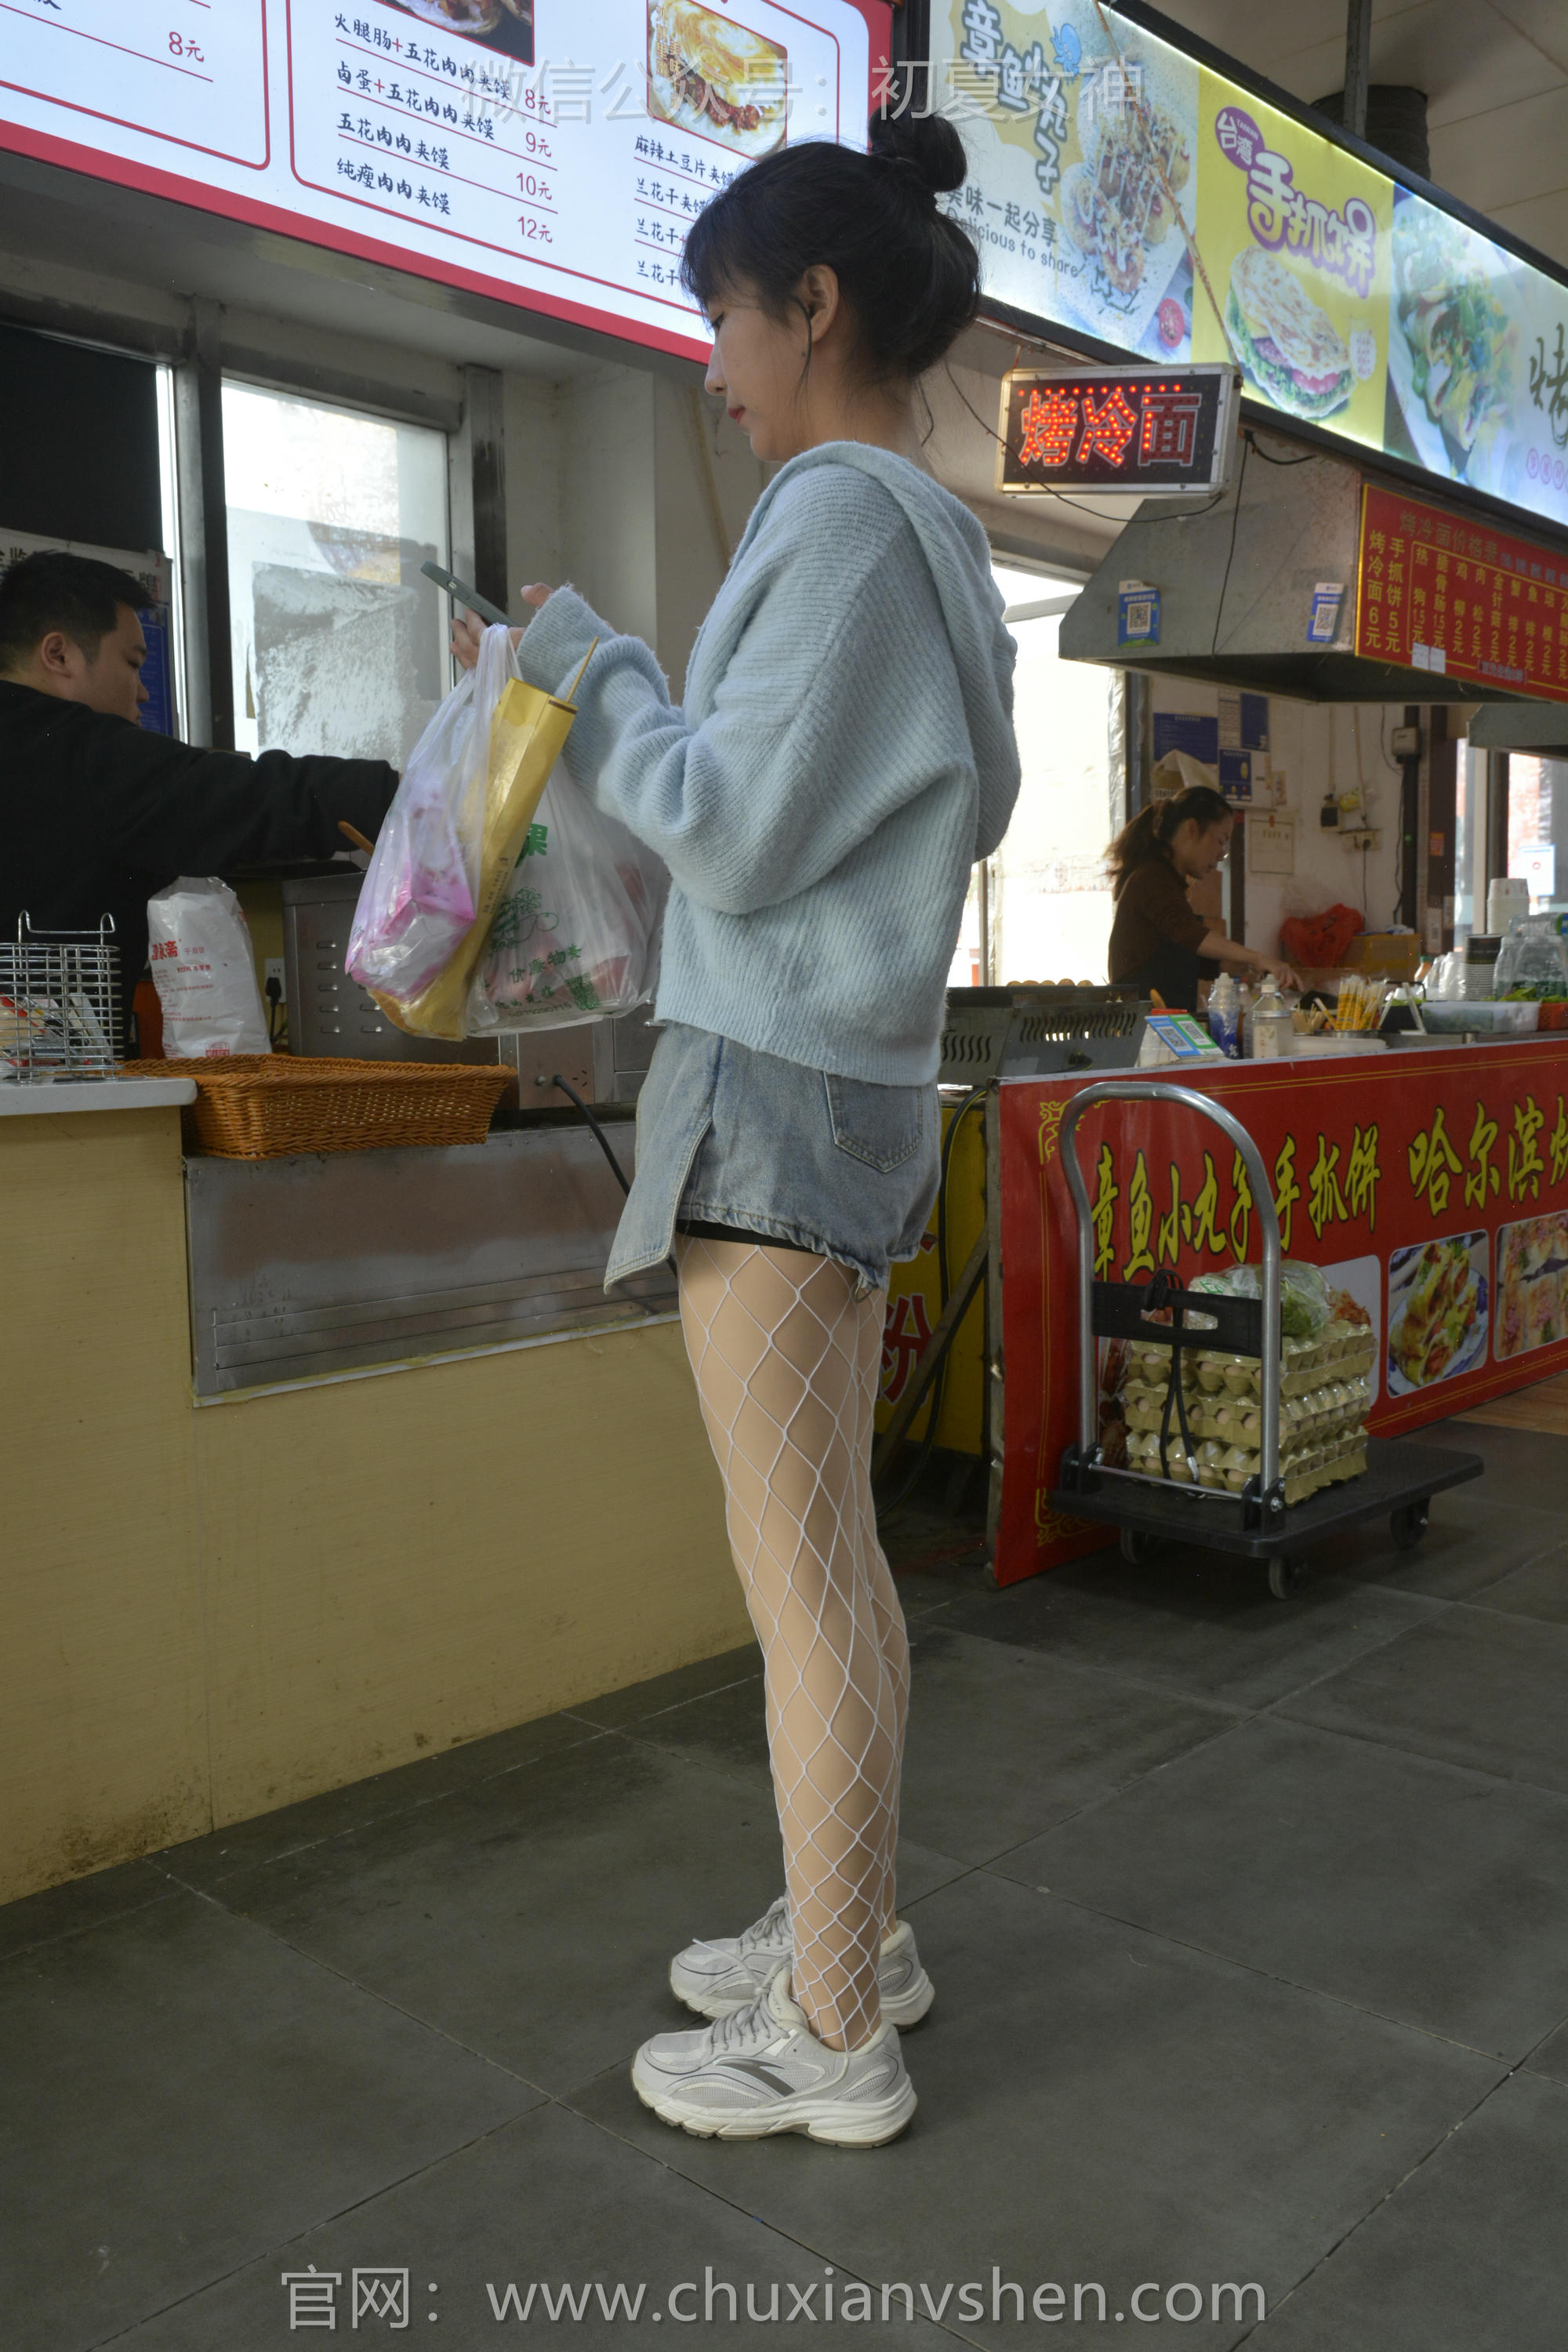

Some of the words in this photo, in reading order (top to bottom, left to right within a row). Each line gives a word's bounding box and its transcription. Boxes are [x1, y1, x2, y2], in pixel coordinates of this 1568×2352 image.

[169, 31, 204, 62] 8元
[334, 13, 510, 101] 火腿肠+五花肉肉夹馍
[524, 89, 551, 114] 8元
[337, 60, 495, 140] 卤蛋+五花肉肉夹馍
[525, 132, 552, 158] 9元
[1217, 111, 1253, 165] 台湾
[336, 113, 450, 170] 五花肉肉夹馍
[516, 172, 552, 200] 10元
[635, 135, 735, 187] 麻辣土豆片夹馍
[336, 158, 451, 215] 纯瘦肉肉夹馍
[517, 216, 553, 244] 12元
[1247, 151, 1375, 296] 手抓饼
[1021, 240, 1036, 260] to
[1041, 252, 1079, 278] share
[1019, 392, 1202, 466] 烤冷面
